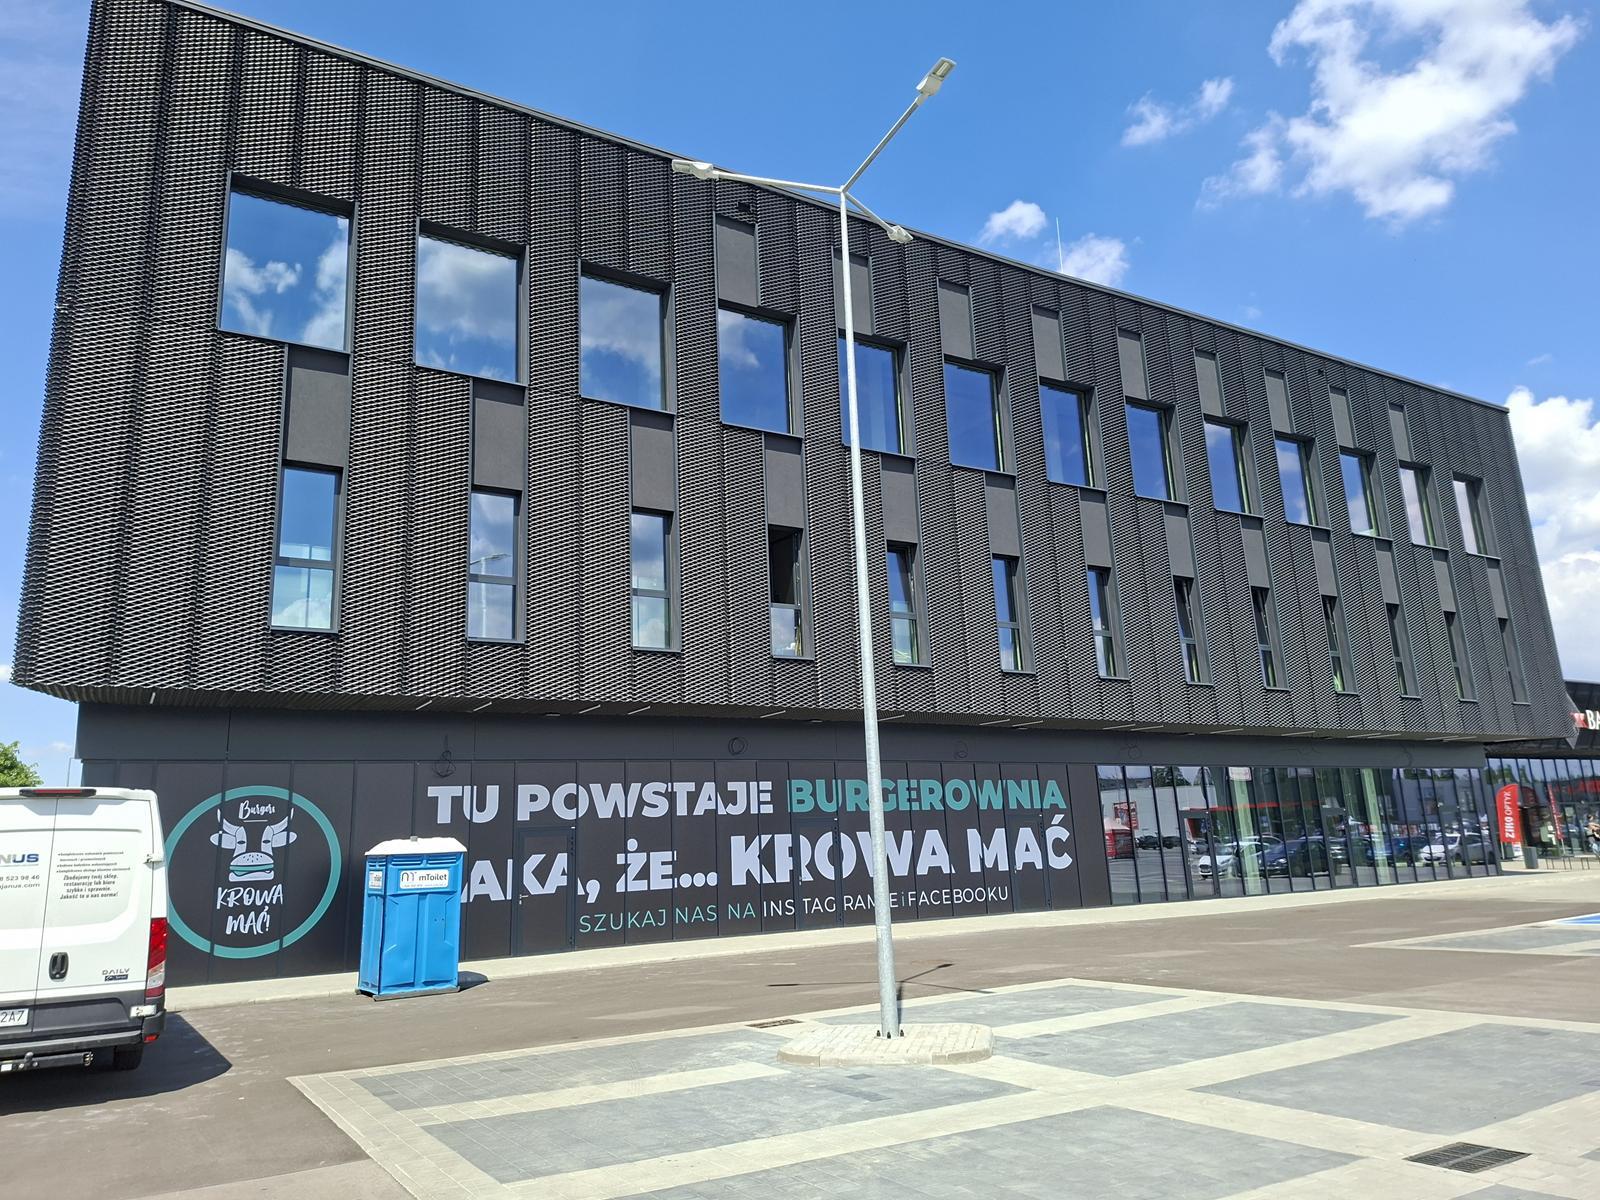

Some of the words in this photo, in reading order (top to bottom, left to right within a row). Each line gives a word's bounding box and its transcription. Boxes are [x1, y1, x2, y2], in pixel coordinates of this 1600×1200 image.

[427, 785, 499, 824] TU
[517, 781, 774, 821] POWSTAJE
[787, 779, 1067, 813] BURGEROWNIA
[418, 873, 447, 881] mToilet
[460, 852, 600, 904] AKA,
[730, 829, 956, 886] KROWA
[966, 814, 1073, 873] MAĆ
[217, 884, 283, 910] KROWA
[578, 909, 667, 933] SZUKAJ
[674, 905, 718, 924] NAS
[728, 905, 756, 920] NA
[907, 886, 1009, 908] FACEBOOKU
[226, 905, 270, 935] MAĆ!
